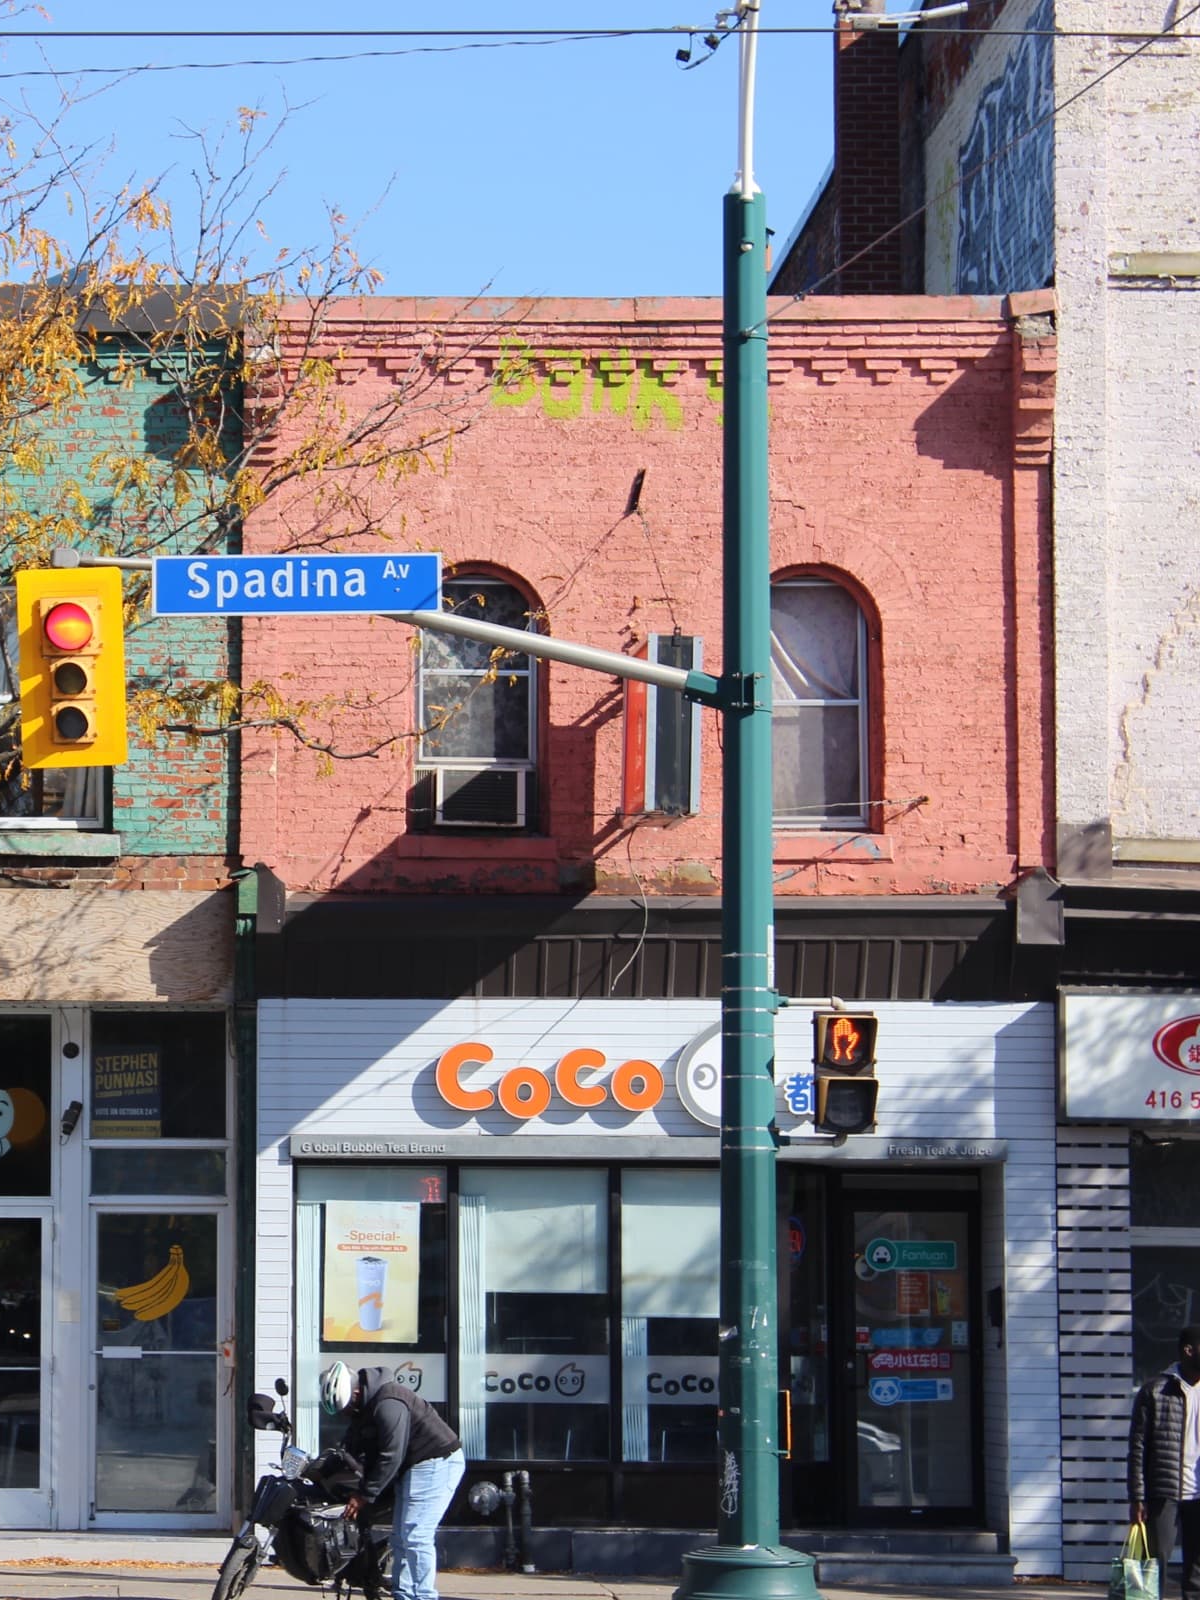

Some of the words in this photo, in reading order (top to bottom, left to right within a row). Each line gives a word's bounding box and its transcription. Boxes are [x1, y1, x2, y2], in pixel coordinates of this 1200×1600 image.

[187, 560, 366, 608] Spadina
[383, 560, 410, 578] Av
[96, 1053, 158, 1073] STEPHEN
[96, 1070, 158, 1090] PUNWASI
[1145, 1090, 1182, 1109] 416
[343, 1142, 383, 1153] Bubble
[386, 1142, 407, 1153] Tea
[410, 1142, 446, 1153] Brand
[889, 1144, 921, 1155] Fresh
[926, 1144, 945, 1155] Tea
[960, 1145, 993, 1156] Juice
